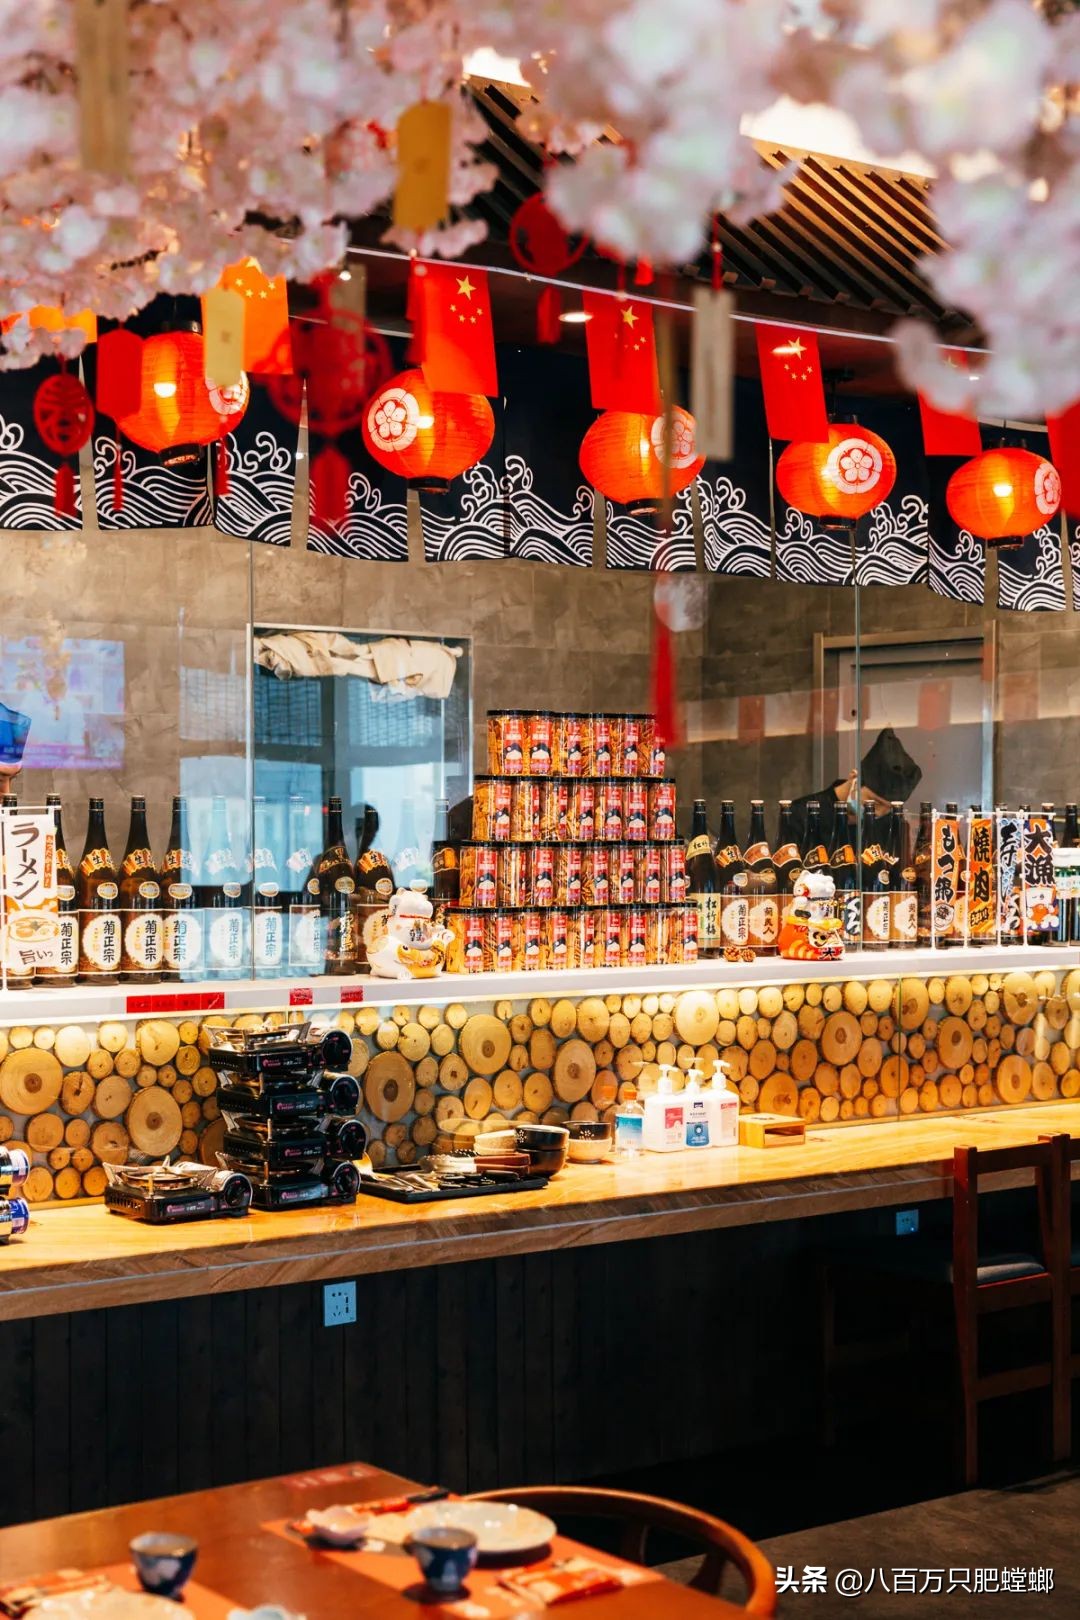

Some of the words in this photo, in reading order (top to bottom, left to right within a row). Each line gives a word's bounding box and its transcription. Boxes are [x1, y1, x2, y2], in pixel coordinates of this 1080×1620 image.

[11, 821, 40, 900] ラーメン
[934, 824, 956, 904] もつ鍋
[973, 827, 991, 903] 焼肉
[1025, 824, 1056, 886] 大漁
[264, 916, 278, 957] 菊正宗
[705, 896, 718, 936] 松竹梅
[737, 904, 748, 940] 菊正宗
[60, 921, 73, 967] 菊正宗
[103, 919, 116, 963] 菊正宗
[144, 919, 158, 963] 菊正宗
[173, 919, 188, 962] 菊正宗
